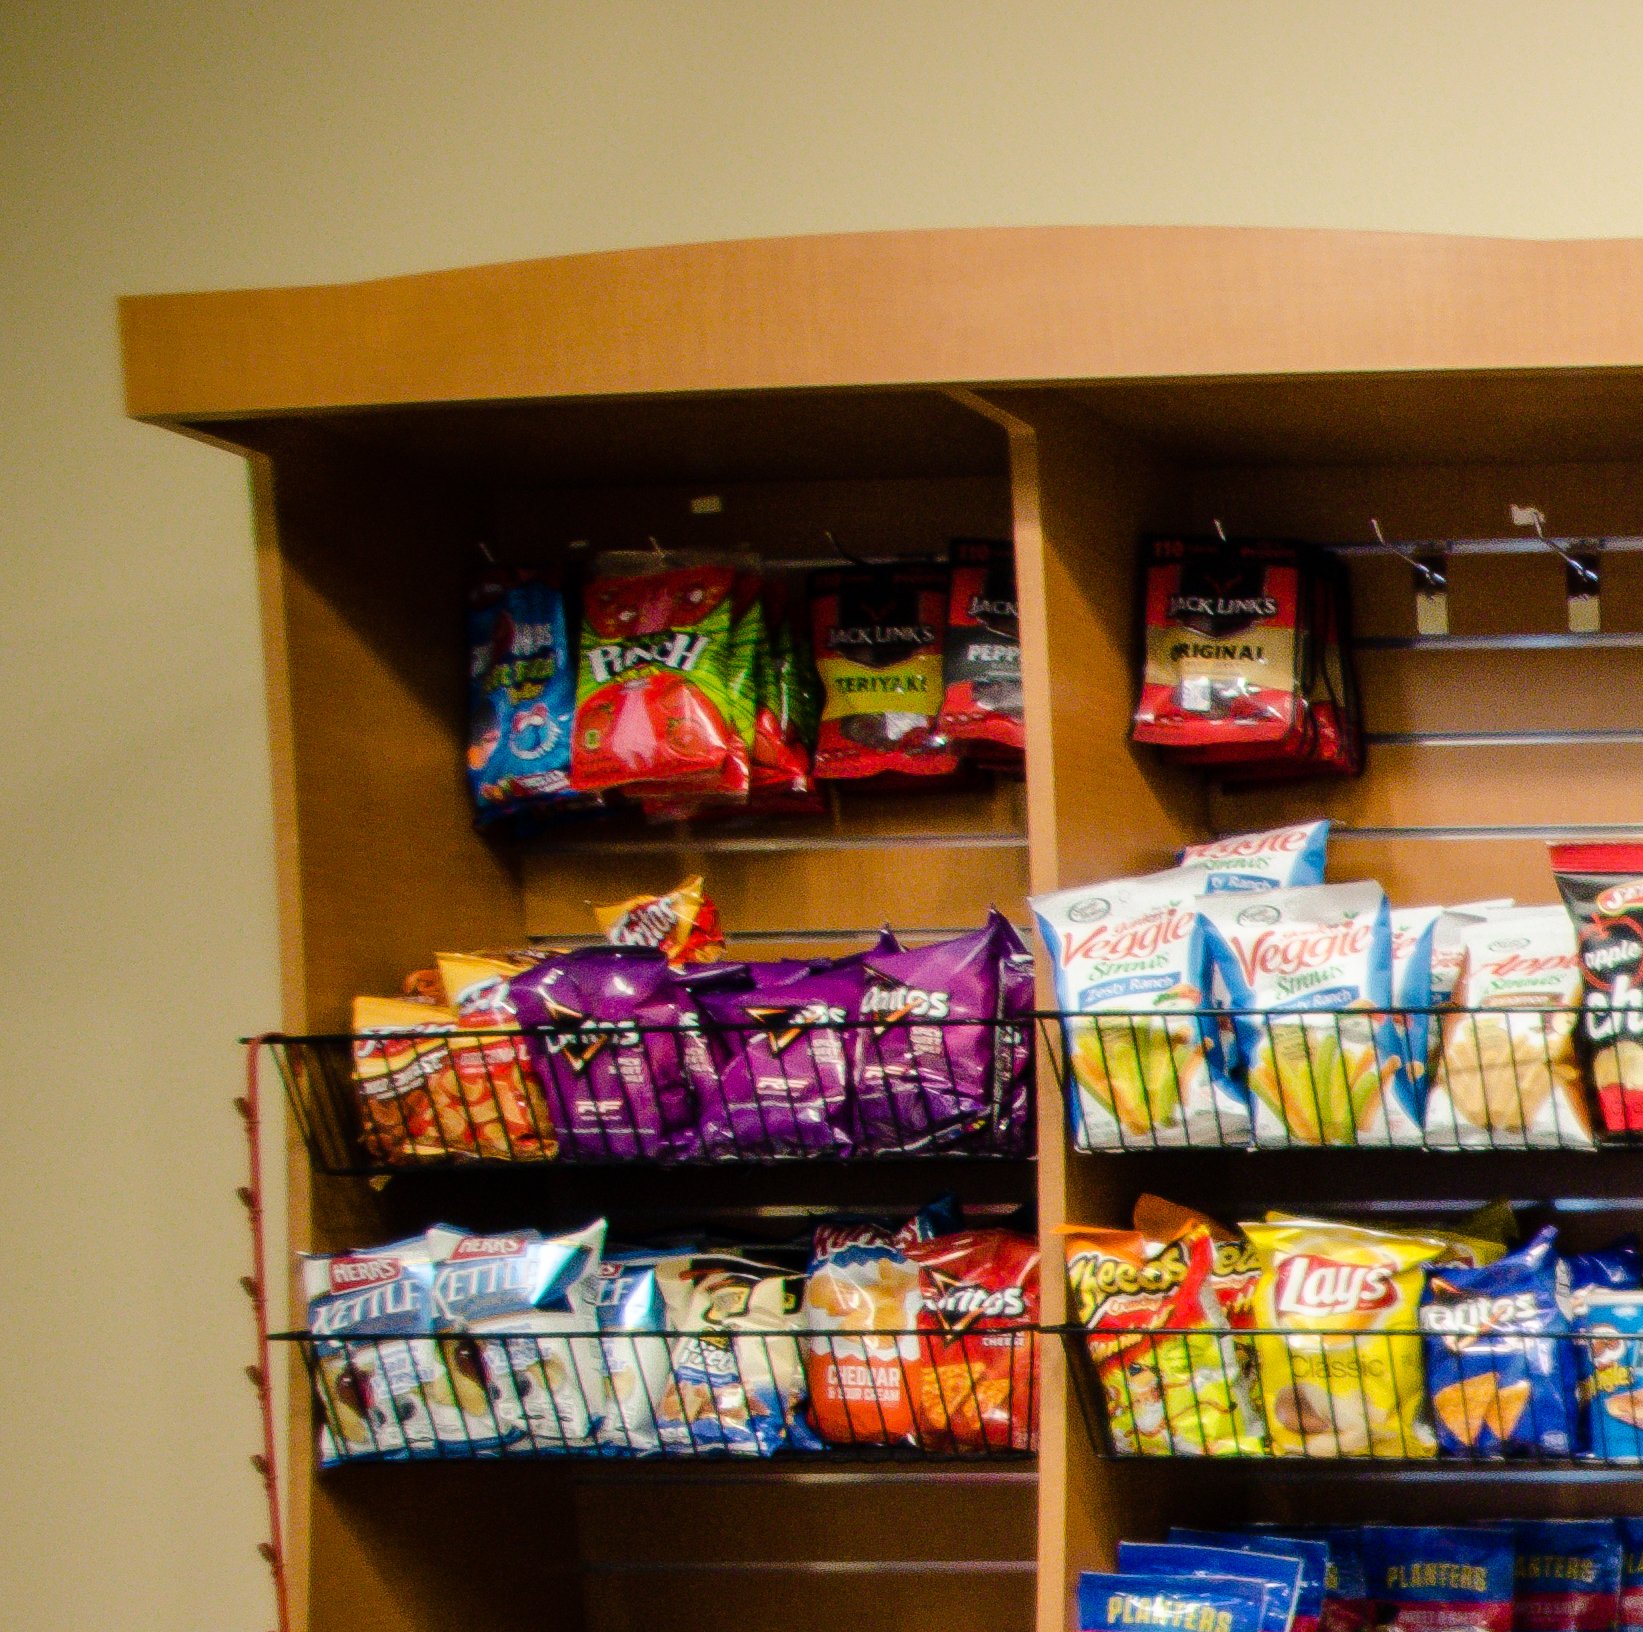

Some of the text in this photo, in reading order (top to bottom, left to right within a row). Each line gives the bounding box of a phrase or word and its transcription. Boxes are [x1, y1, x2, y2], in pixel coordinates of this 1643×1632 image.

[1061, 907, 1196, 970] Veggie
[1231, 918, 1374, 989] Veggie
[1584, 939, 1643, 970] apple
[1290, 1354, 1386, 1380] Classic
